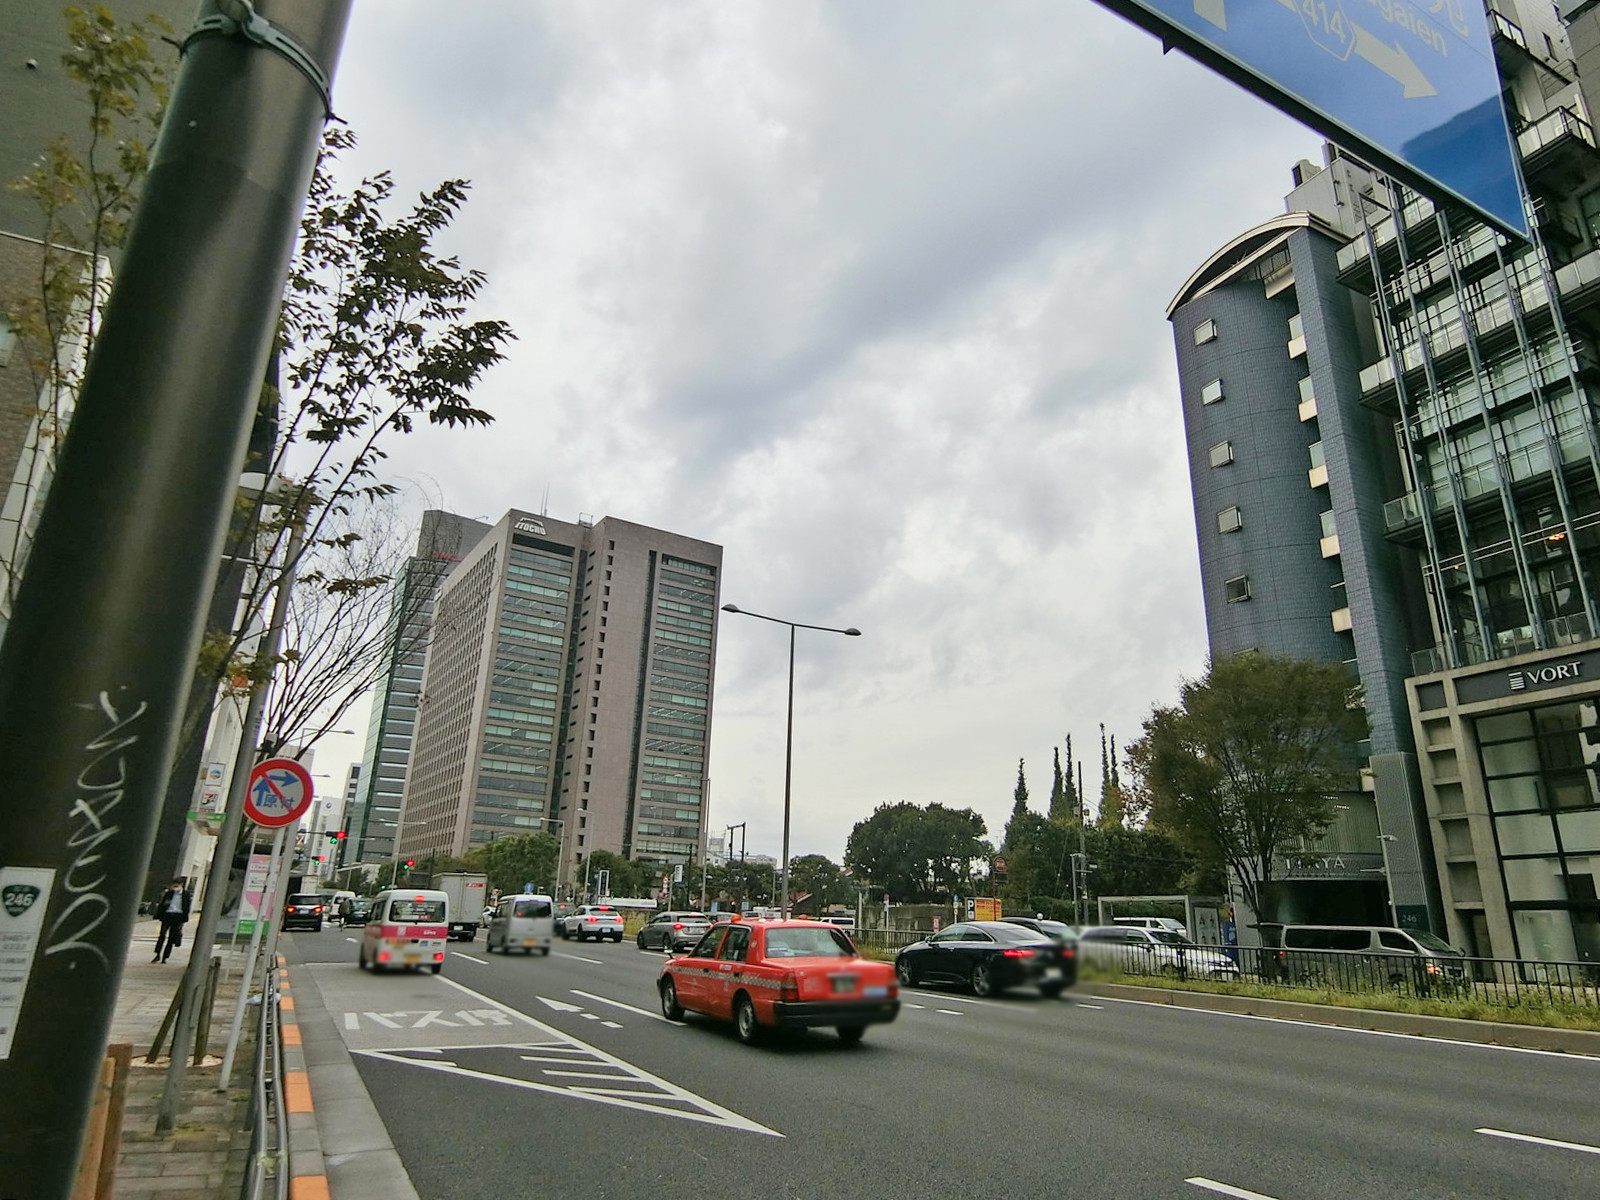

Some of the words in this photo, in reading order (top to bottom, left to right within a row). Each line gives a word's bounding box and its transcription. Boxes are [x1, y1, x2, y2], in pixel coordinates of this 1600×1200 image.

[1302, 0, 1345, 44] 414
[1369, 0, 1448, 57] gaien
[514, 518, 547, 536] ITOCHU
[1527, 661, 1581, 684] VORT
[5, 892, 35, 906] 246
[967, 900, 975, 911] P
